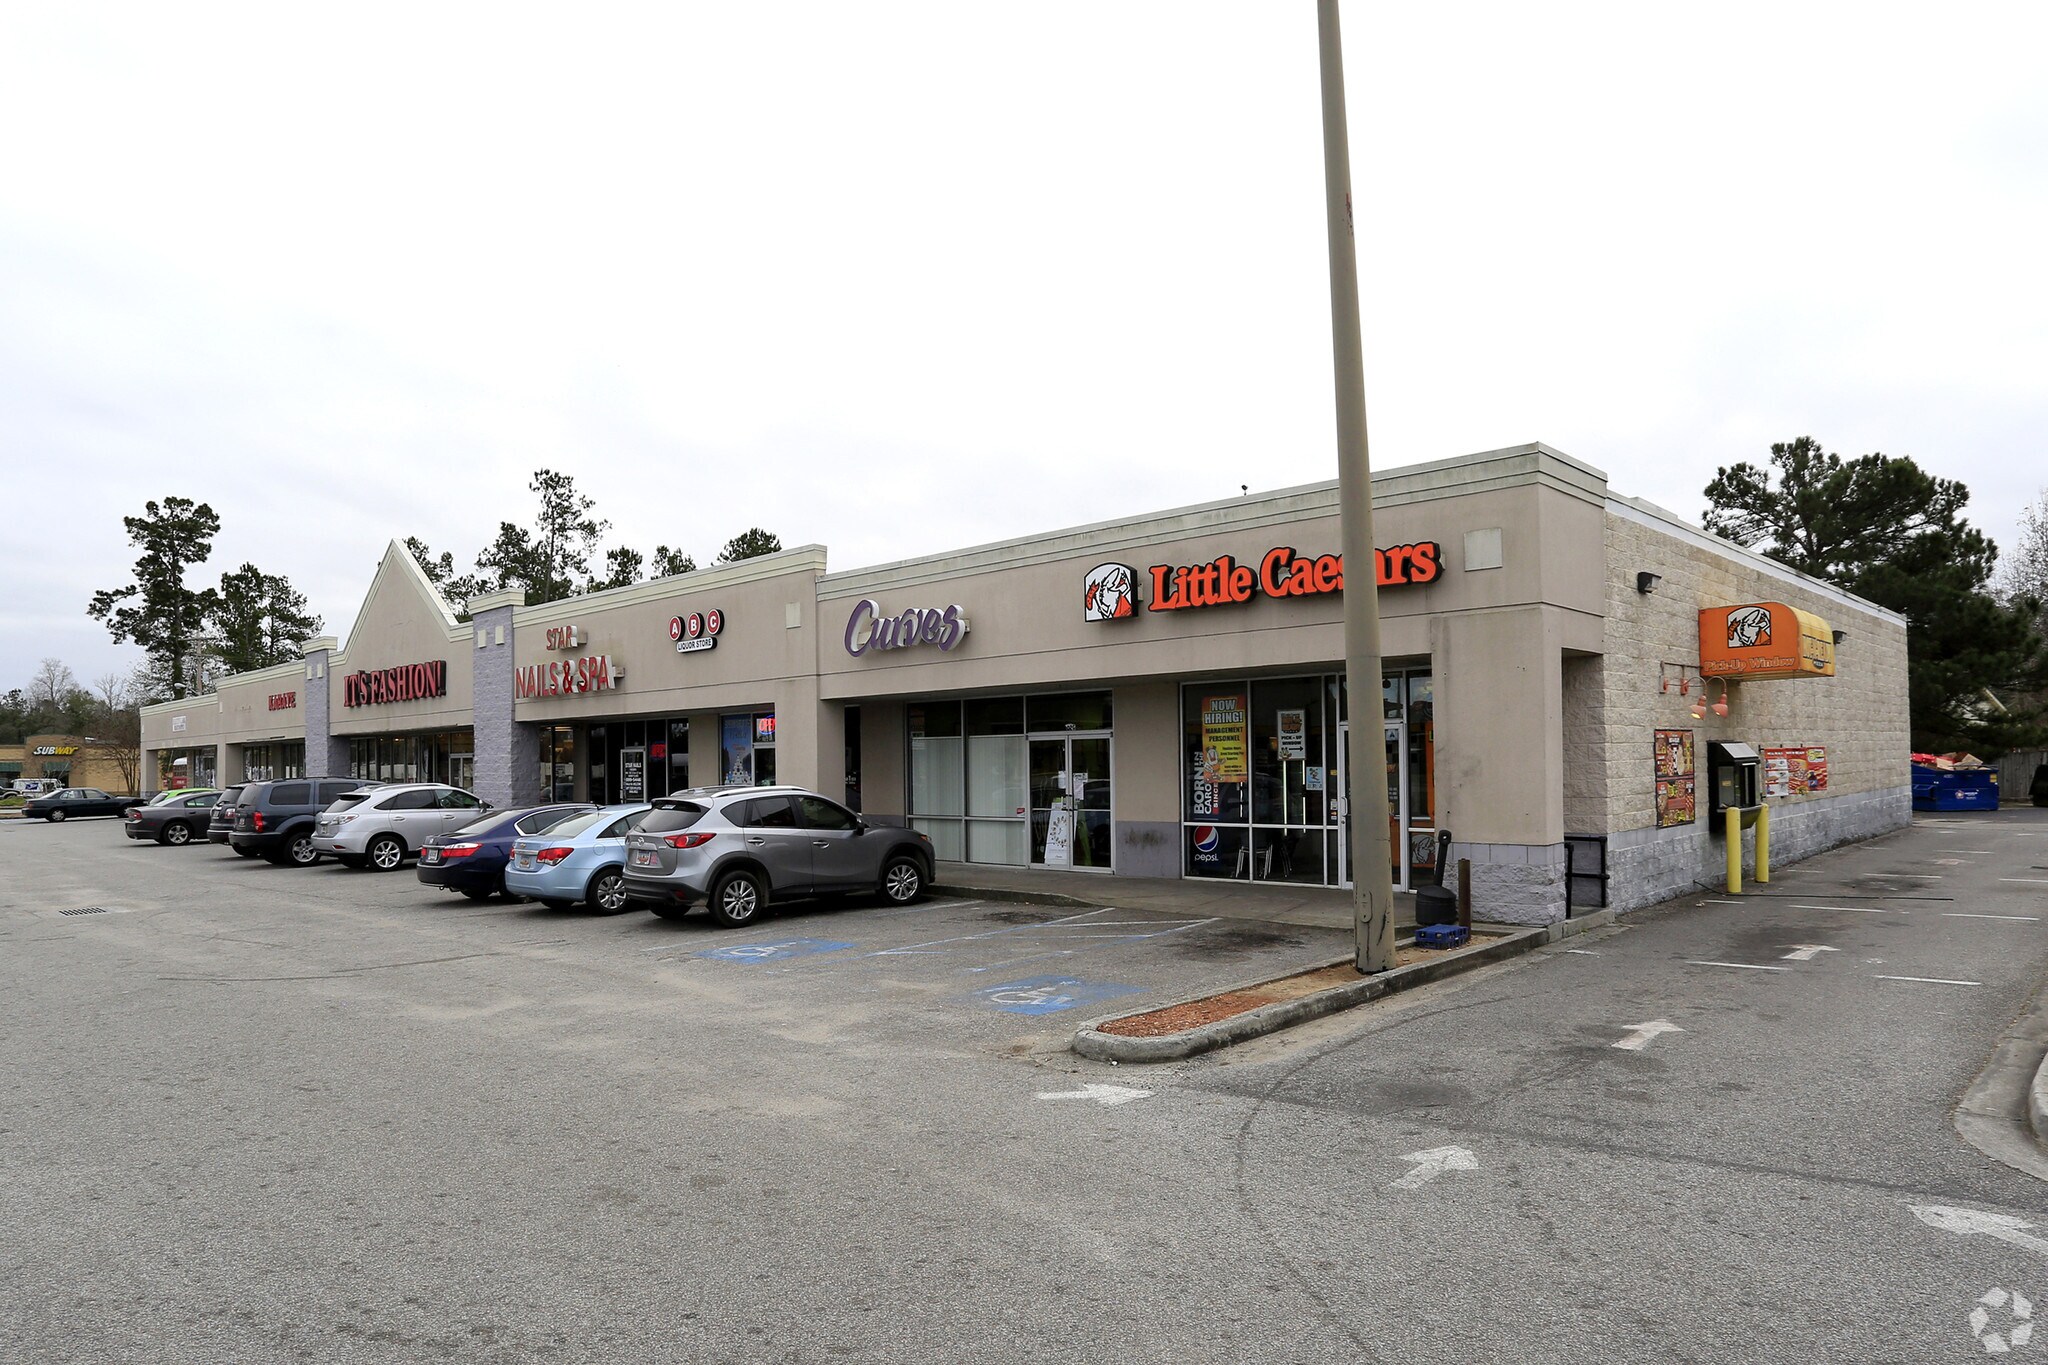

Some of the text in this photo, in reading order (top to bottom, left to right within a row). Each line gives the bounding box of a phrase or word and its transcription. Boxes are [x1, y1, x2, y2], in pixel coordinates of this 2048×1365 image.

[1148, 555, 1254, 612] Little
[844, 599, 963, 657] Curves
[546, 625, 575, 651] STAR
[678, 638, 712, 651] LIQUOR STORE
[1704, 656, 1795, 672] Pick-Up Window
[343, 660, 446, 707] IT'S FASHION!
[515, 655, 611, 699] NAILS & SPA
[1211, 700, 1236, 711] NOW
[759, 718, 775, 731] OPE
[1204, 711, 1243, 724] HIRING!
[33, 746, 79, 755] SUBWAY
[1194, 767, 1204, 814] BORN
[1194, 853, 1218, 862] pepsi
